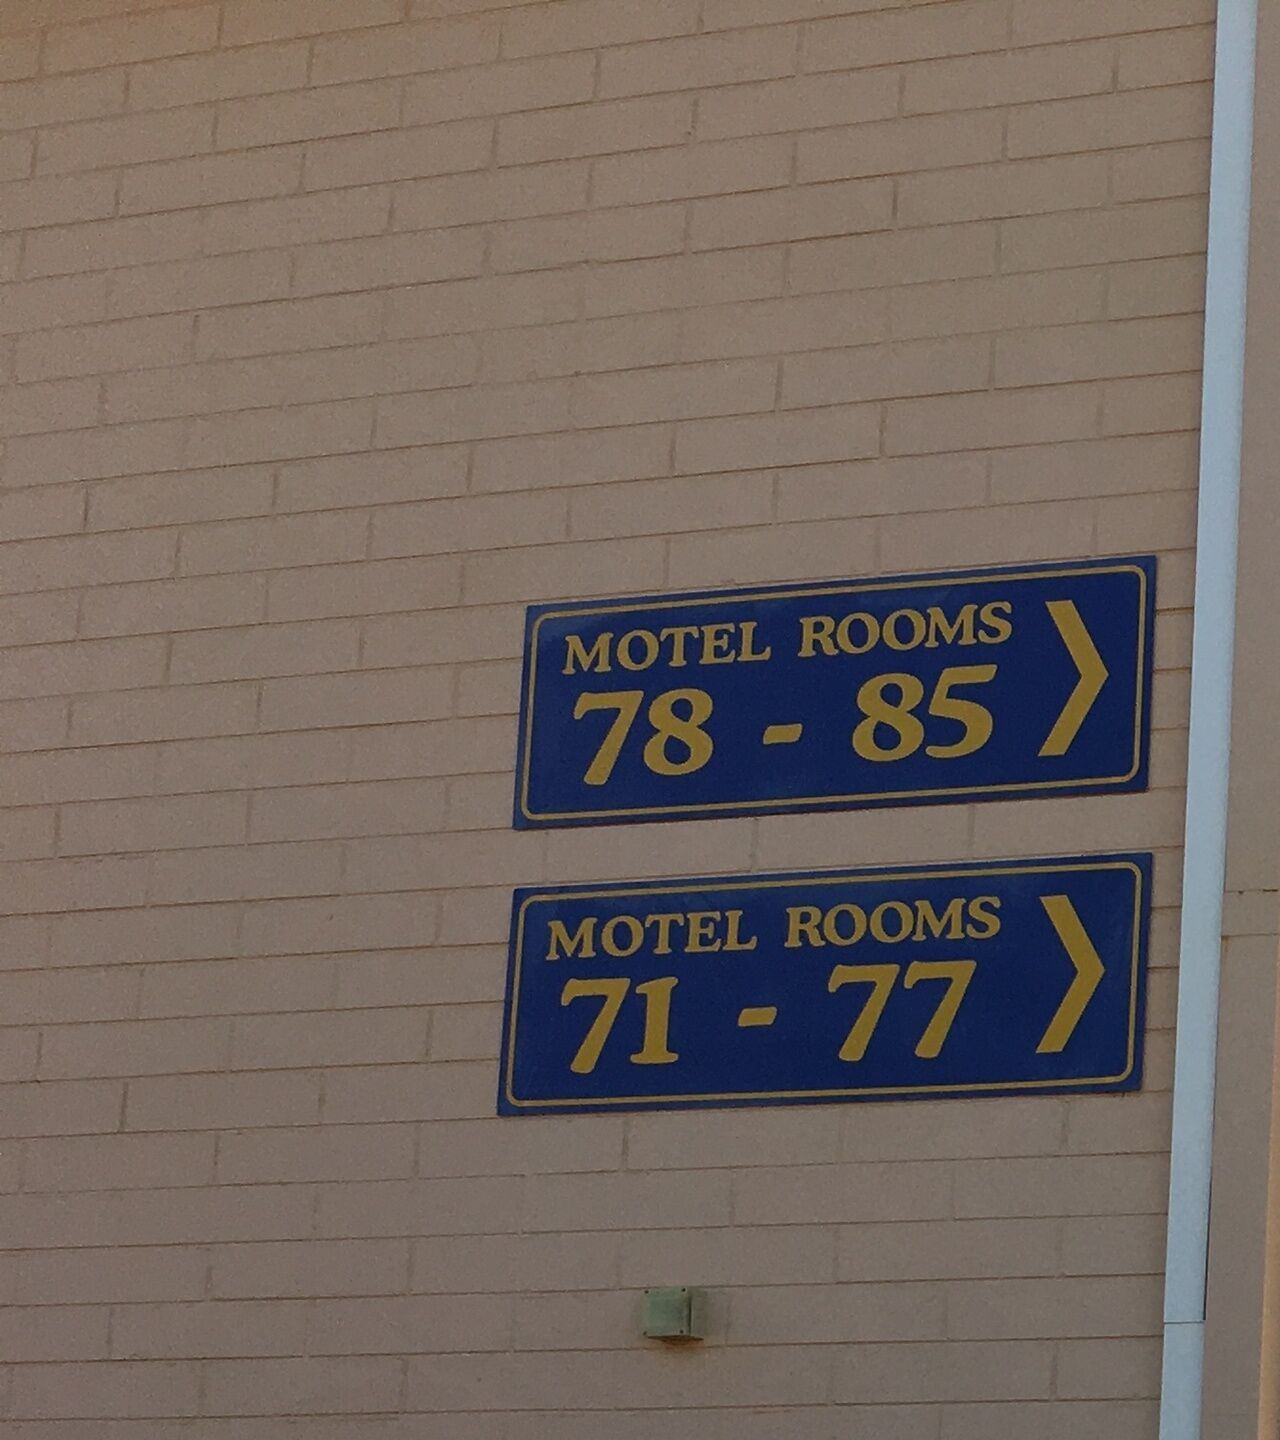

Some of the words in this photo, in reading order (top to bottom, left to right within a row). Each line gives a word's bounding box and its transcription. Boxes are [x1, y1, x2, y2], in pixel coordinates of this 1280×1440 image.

[563, 621, 771, 675] MOTEL
[798, 601, 1013, 657] ROOMS
[573, 688, 714, 785] 78
[762, 723, 803, 745] -
[851, 664, 998, 762] 85
[546, 909, 757, 961] MOTEL
[784, 895, 1002, 948] ROOMS
[560, 976, 679, 1074] 71
[737, 1006, 778, 1028] -
[827, 960, 977, 1062] 77
